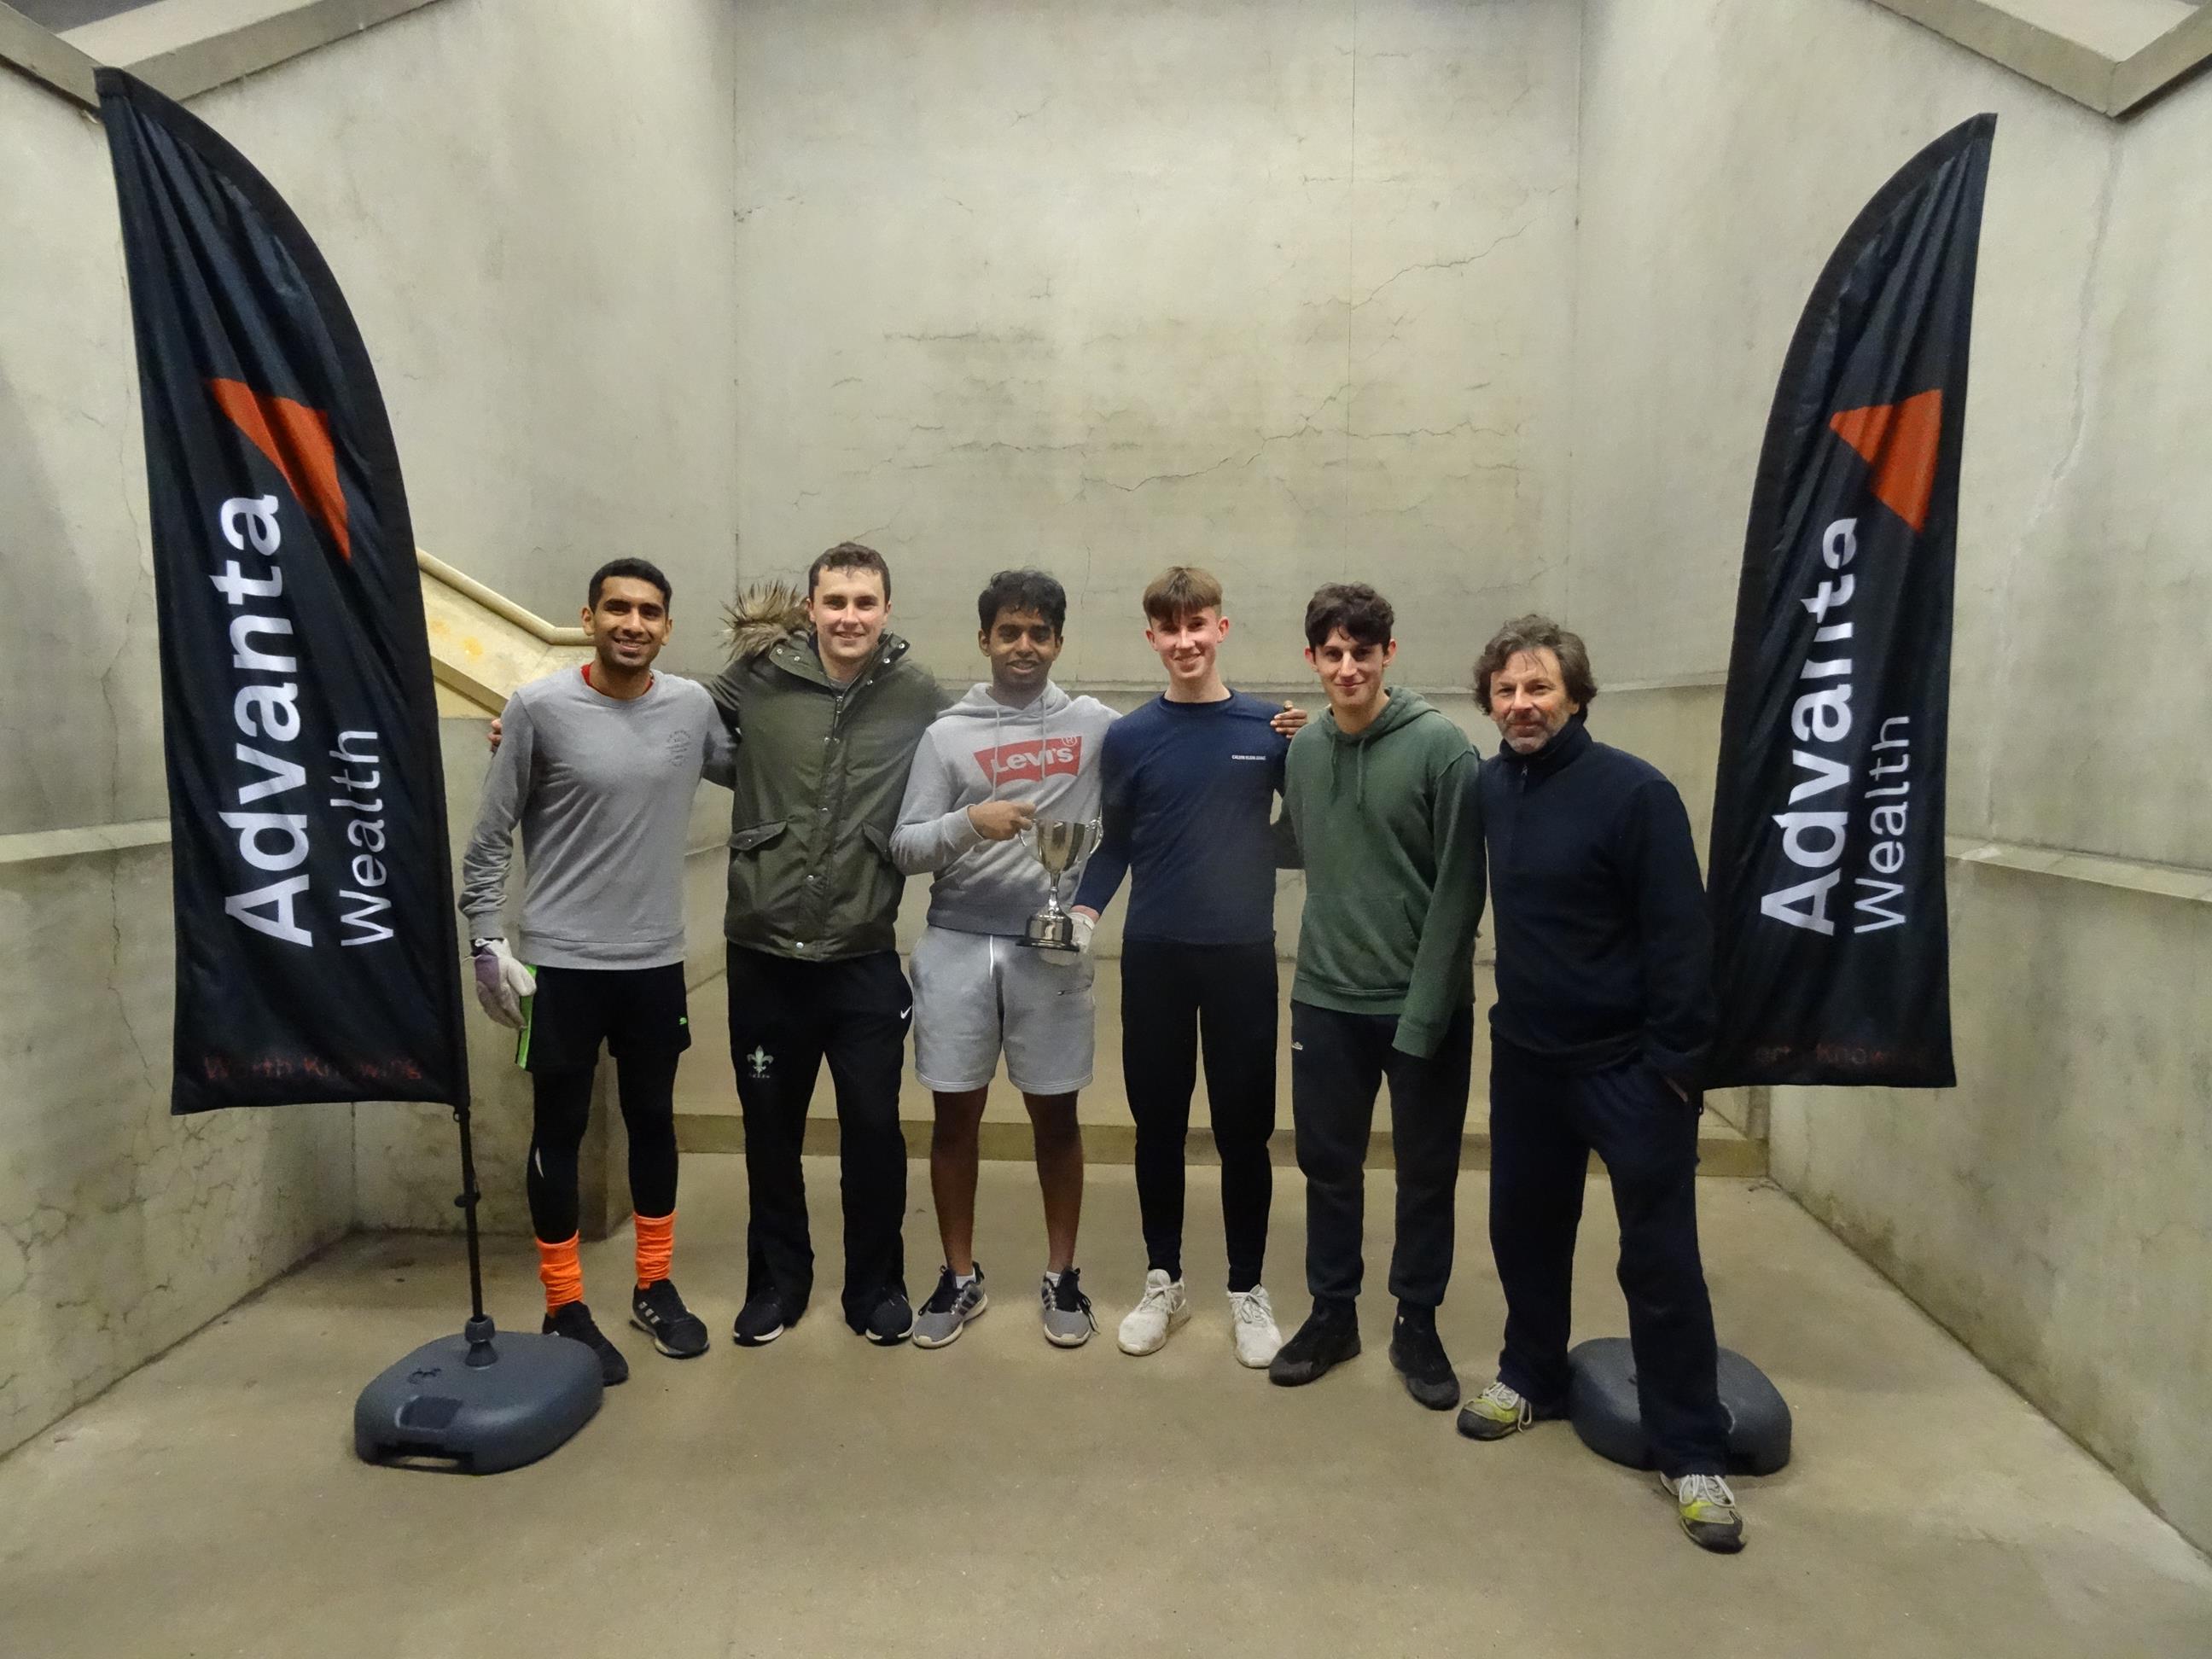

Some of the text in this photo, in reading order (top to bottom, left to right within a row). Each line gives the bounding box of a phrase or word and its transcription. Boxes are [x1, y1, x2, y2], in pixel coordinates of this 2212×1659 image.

[210, 493, 313, 948] Advanta
[329, 730, 395, 947] Wealth
[1761, 517, 1858, 936] Advanta
[1854, 715, 1911, 934] Wealth
